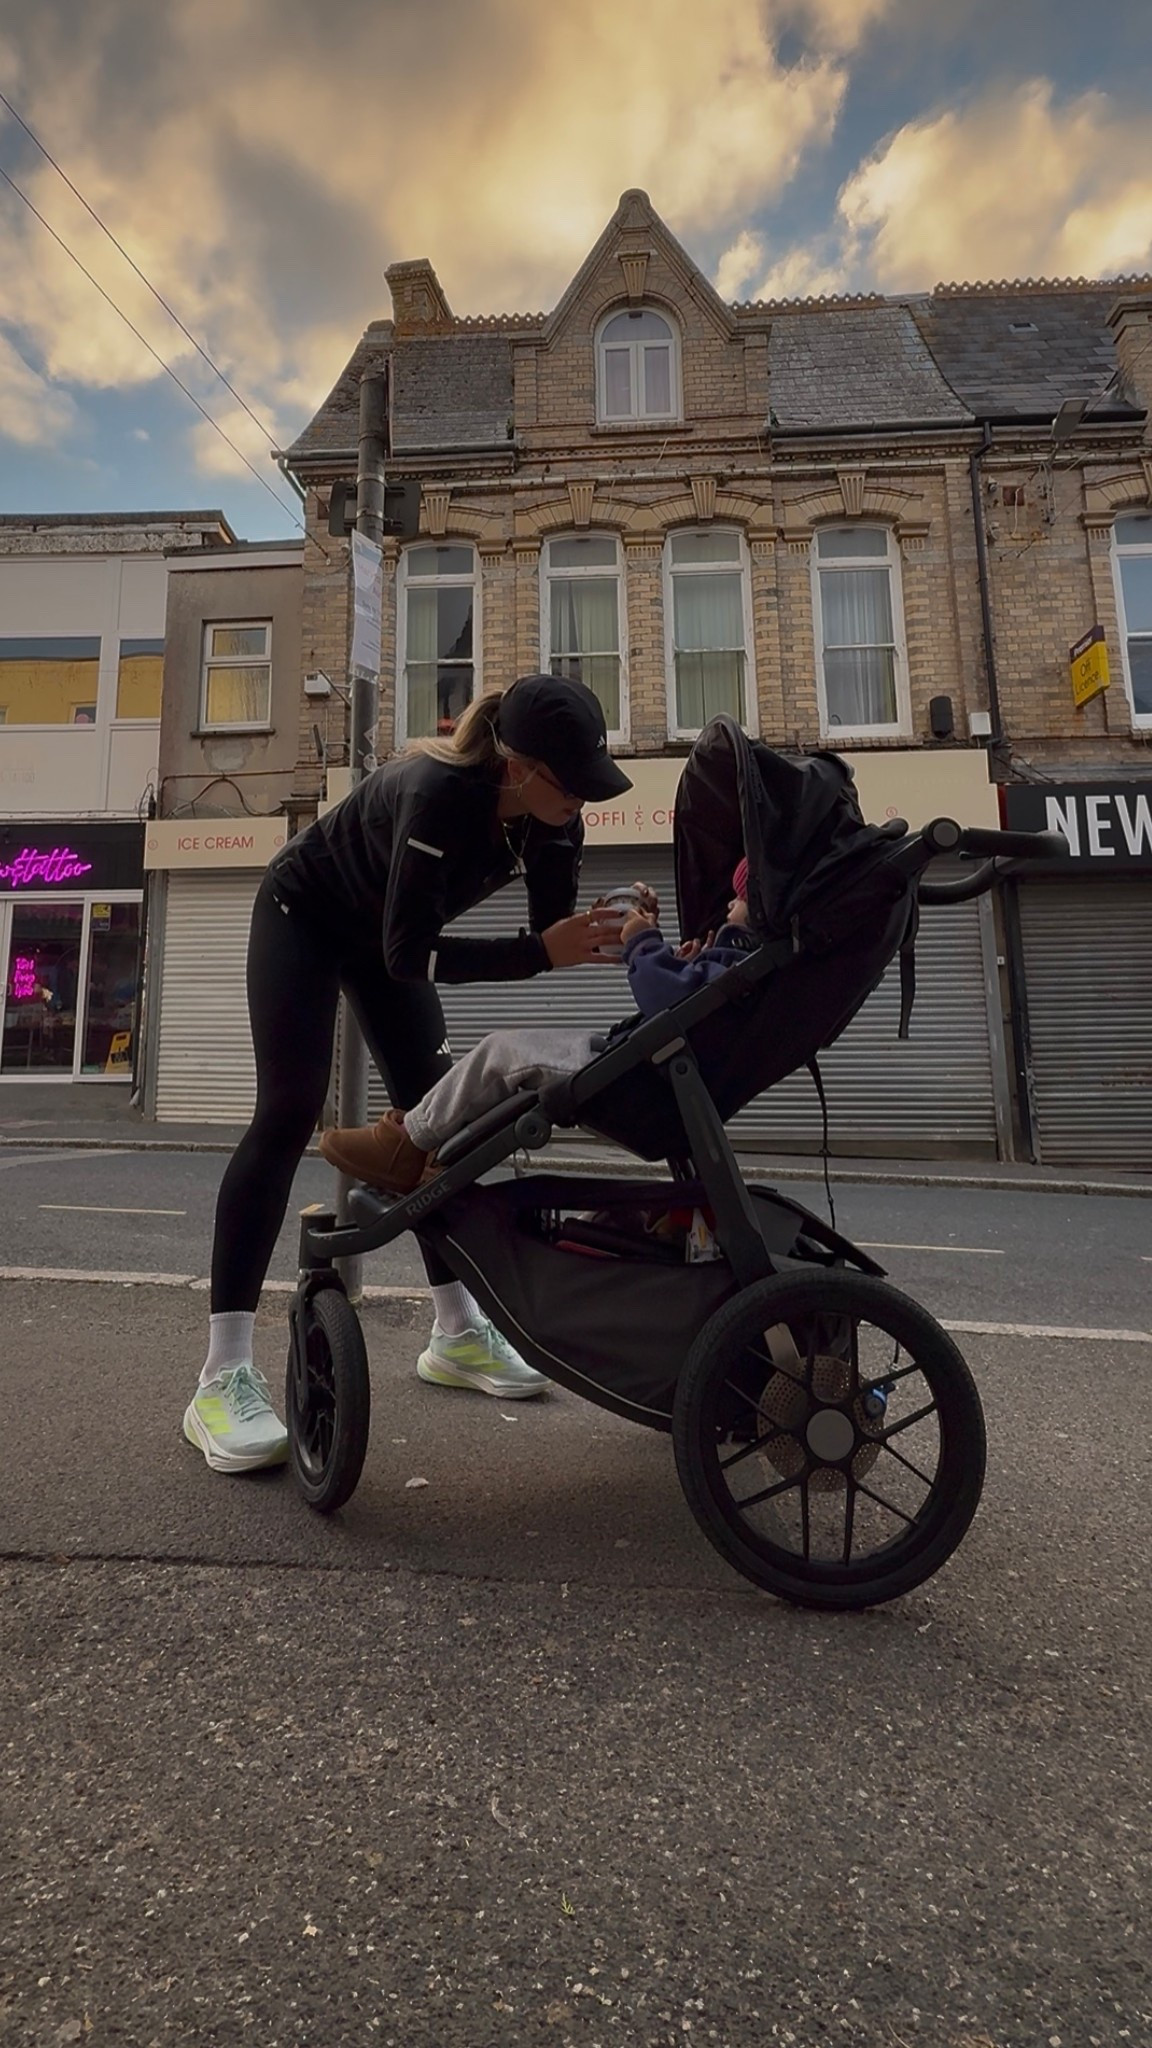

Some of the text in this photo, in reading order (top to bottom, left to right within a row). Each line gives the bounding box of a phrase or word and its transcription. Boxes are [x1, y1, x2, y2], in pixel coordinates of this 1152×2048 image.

[1080, 658, 1091, 677] Off
[582, 811, 625, 827] OFFI
[1045, 794, 1152, 857] NEW
[178, 836, 254, 850] ICE CREAM
[405, 1179, 452, 1217] RIDGE
